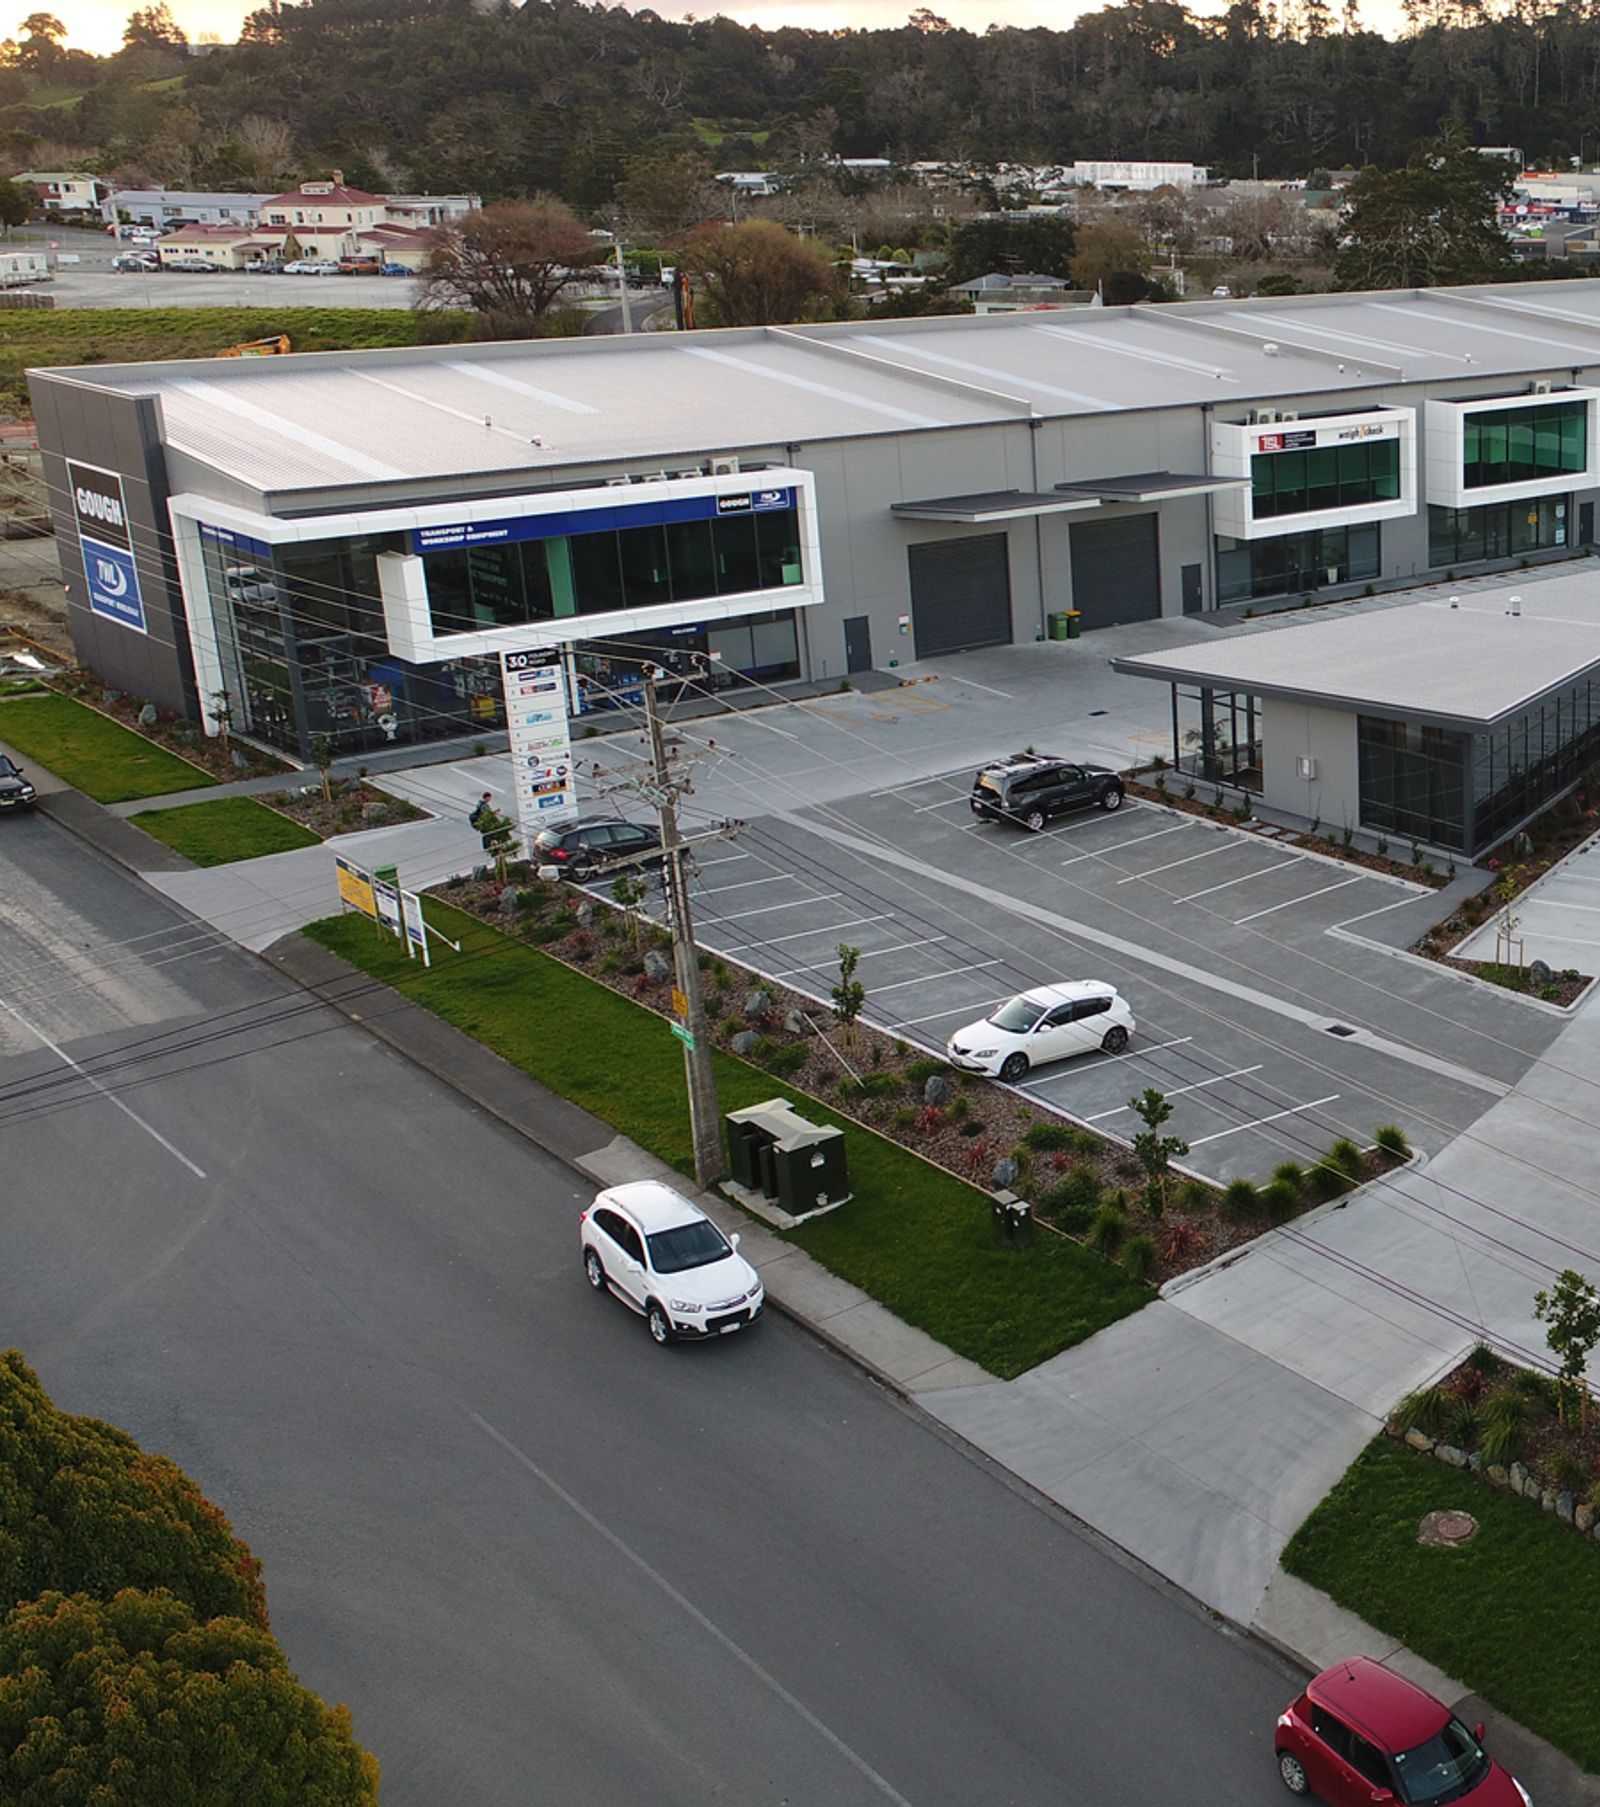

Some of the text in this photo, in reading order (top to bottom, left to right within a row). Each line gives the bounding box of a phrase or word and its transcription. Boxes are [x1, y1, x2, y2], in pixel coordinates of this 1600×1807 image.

[76, 487, 124, 526] GOUGH
[420, 526, 465, 537] TRANSPORT
[421, 529, 508, 546] WORKSHOP EQUIPMENT
[508, 655, 528, 669] 30
